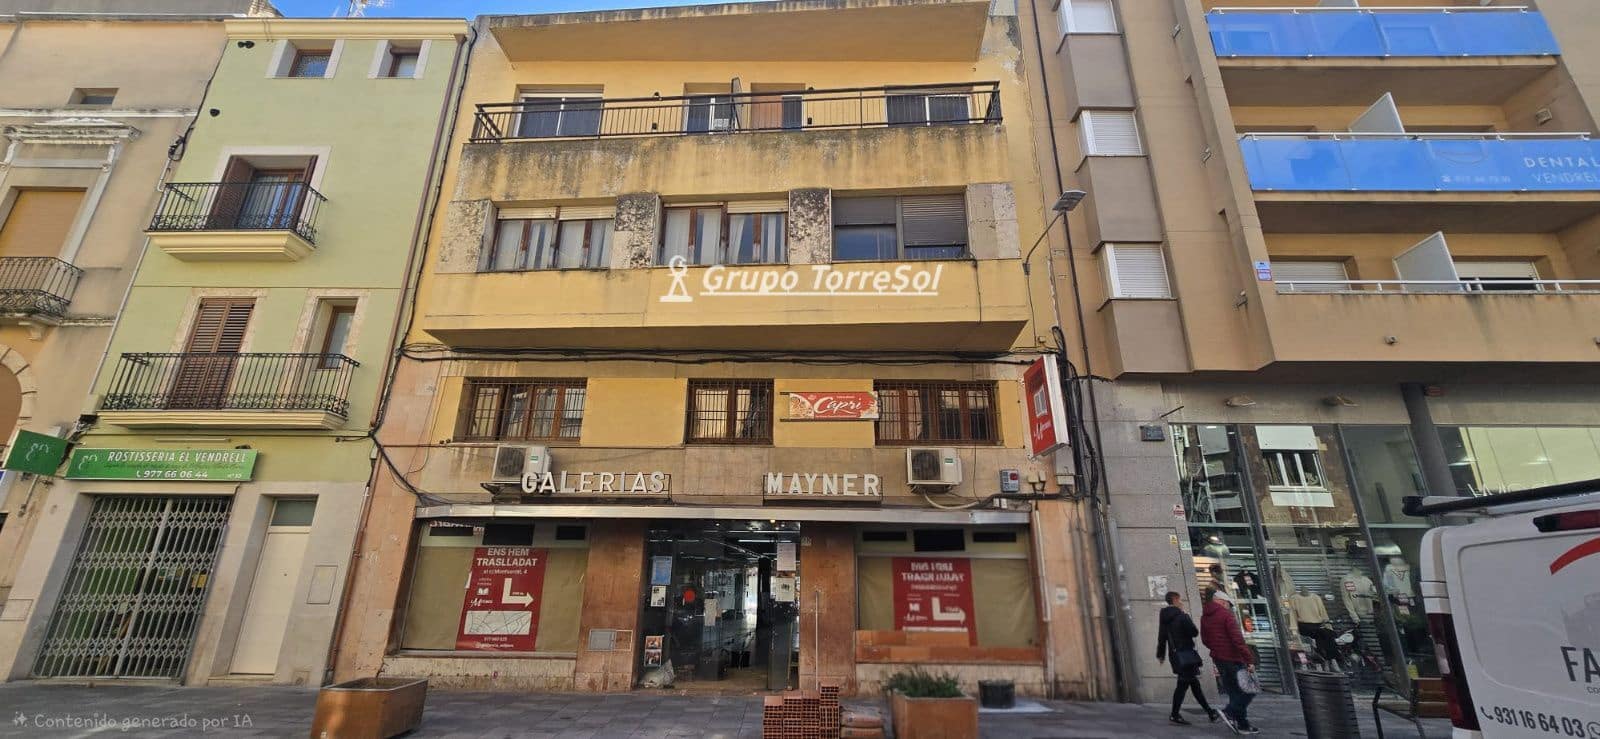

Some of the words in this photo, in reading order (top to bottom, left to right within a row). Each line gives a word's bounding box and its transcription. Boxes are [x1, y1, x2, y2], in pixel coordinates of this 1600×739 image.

[1523, 156, 1600, 169] DENTAL
[813, 396, 862, 414] Capri
[107, 451, 175, 462] ROSTISSERIA
[179, 451, 190, 462] EL
[195, 451, 247, 462] VENDRELL
[143, 470, 162, 478] 977
[165, 470, 177, 478] 66
[180, 470, 193, 478] 06
[521, 470, 665, 494] GALERIAS
[766, 472, 880, 496] MAYNER
[487, 547, 507, 556] ENS
[508, 548, 530, 556] HEM
[476, 557, 538, 567] TRASLLADAT
[1494, 706, 1519, 726] 931
[1519, 709, 1536, 729] 16
[1538, 713, 1560, 734] 64
[1561, 716, 1586, 738] 03
